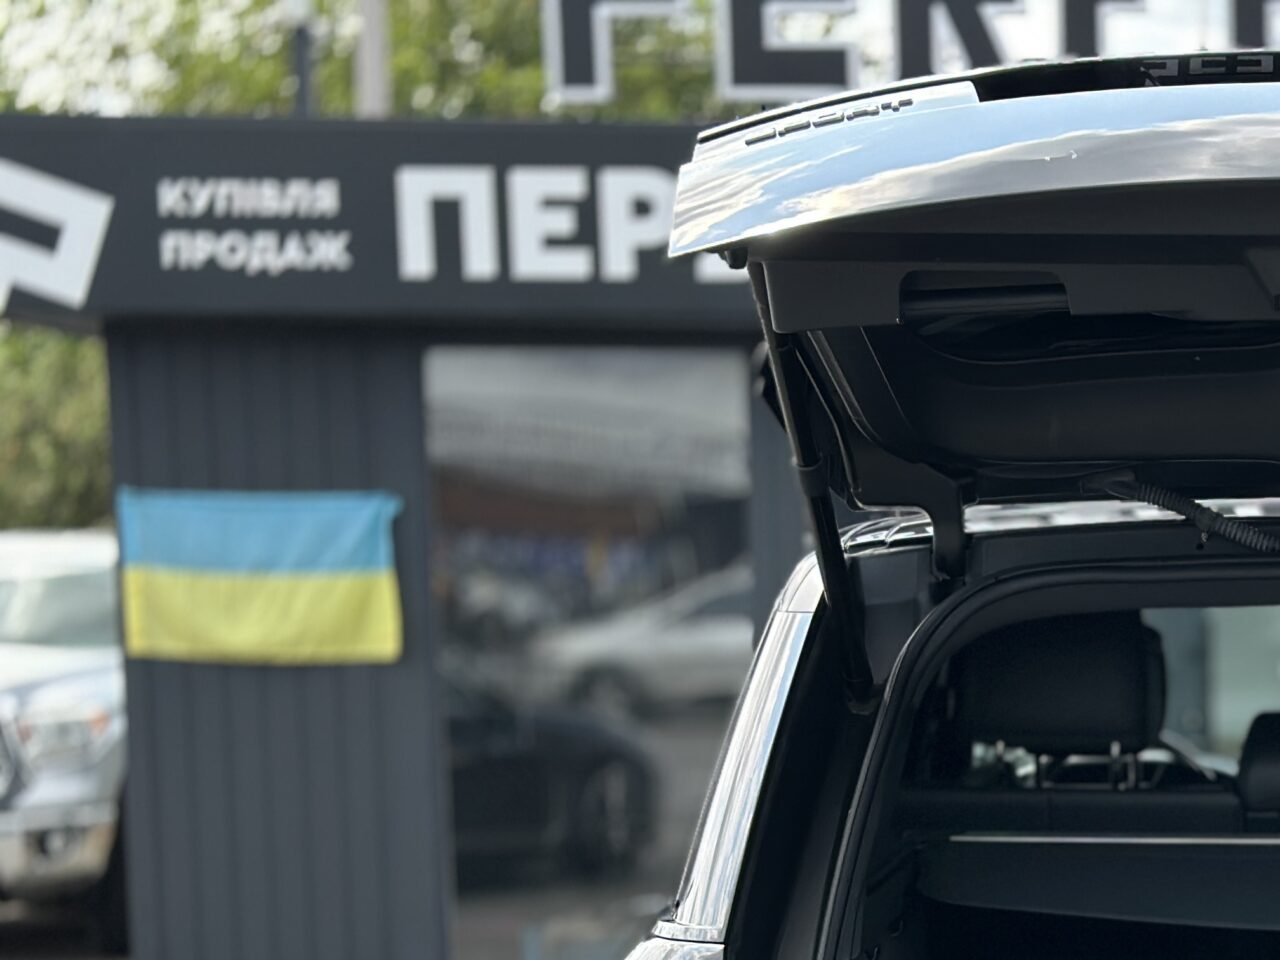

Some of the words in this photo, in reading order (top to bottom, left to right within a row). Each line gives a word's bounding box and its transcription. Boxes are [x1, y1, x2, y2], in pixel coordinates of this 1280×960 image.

[157, 177, 341, 219] КУПІВЛЯ
[393, 164, 752, 284] ПЕР
[159, 229, 353, 277] ПРОДАЖ
